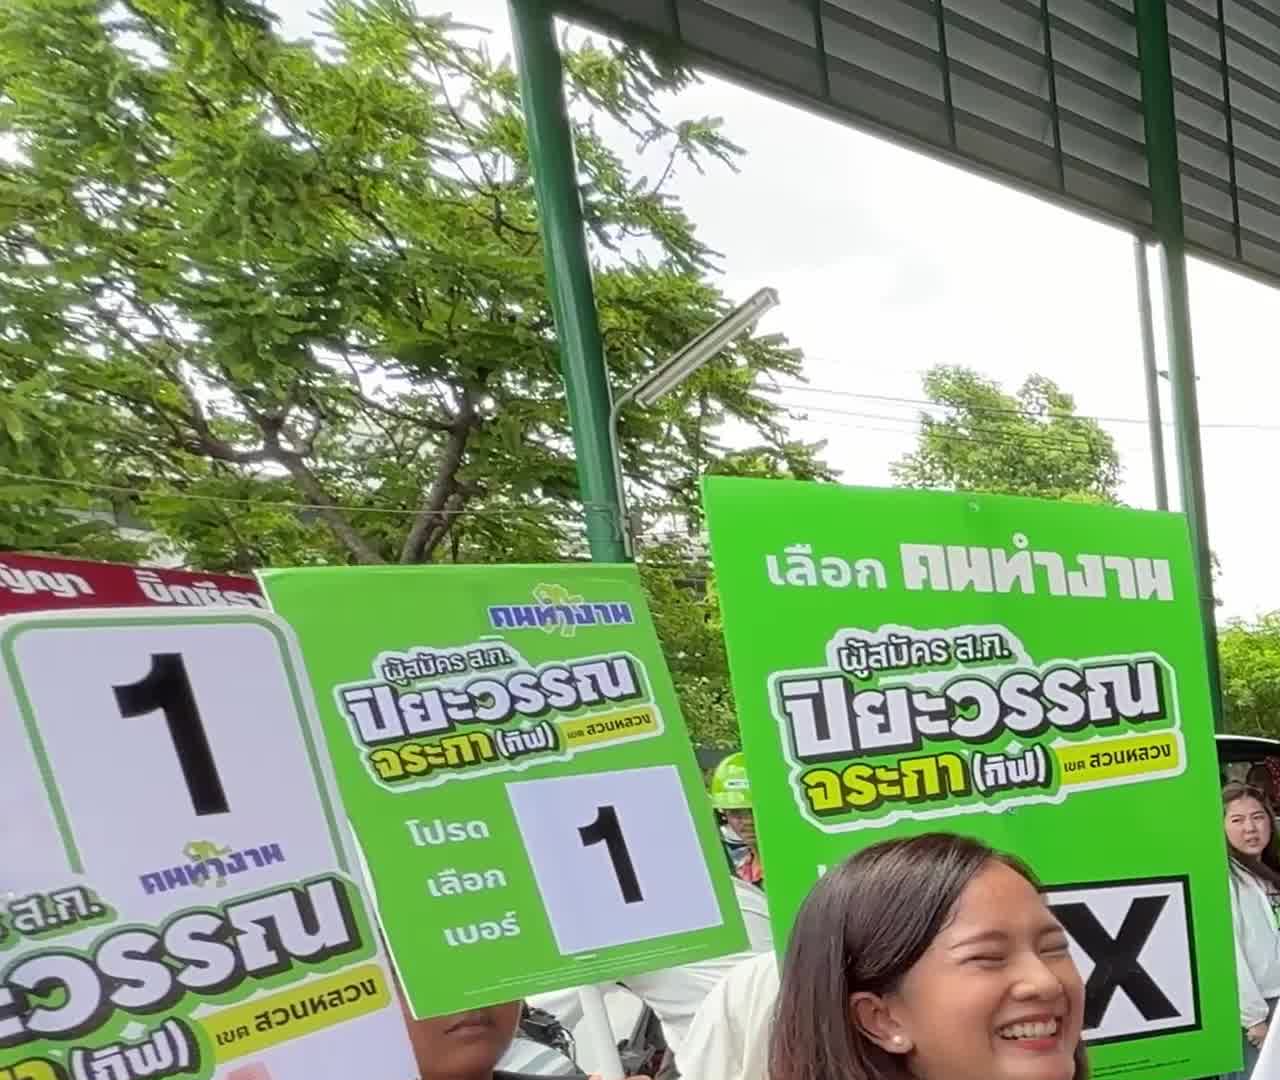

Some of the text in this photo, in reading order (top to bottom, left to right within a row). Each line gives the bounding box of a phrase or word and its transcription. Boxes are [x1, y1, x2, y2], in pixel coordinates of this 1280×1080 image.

[766, 532, 1174, 600] เลือก คนทำงาน
[383, 647, 514, 686] ผู้สมัคร ส.ก.
[838, 632, 1011, 679] ผู้สมัคร ส.ก.
[343, 656, 638, 743] ปิยะวรรณ
[781, 662, 1161, 757] ปิยะวรรณ
[112, 652, 231, 817] 1
[369, 731, 494, 780] จระกา
[586, 713, 652, 736] สวนหลวง
[801, 751, 968, 813] จระกา
[970, 744, 1049, 793] (กิฟ)
[1088, 743, 1172, 770] สวนหลวง
[405, 818, 490, 847] โปรด
[577, 804, 644, 905] 1
[11, 886, 102, 934] ส.ก.
[426, 867, 507, 898] เลือก
[0, 879, 352, 1039] วรรณ
[444, 911, 521, 947] เบอร์
[215, 977, 378, 1047] เขต สวนหลวง
